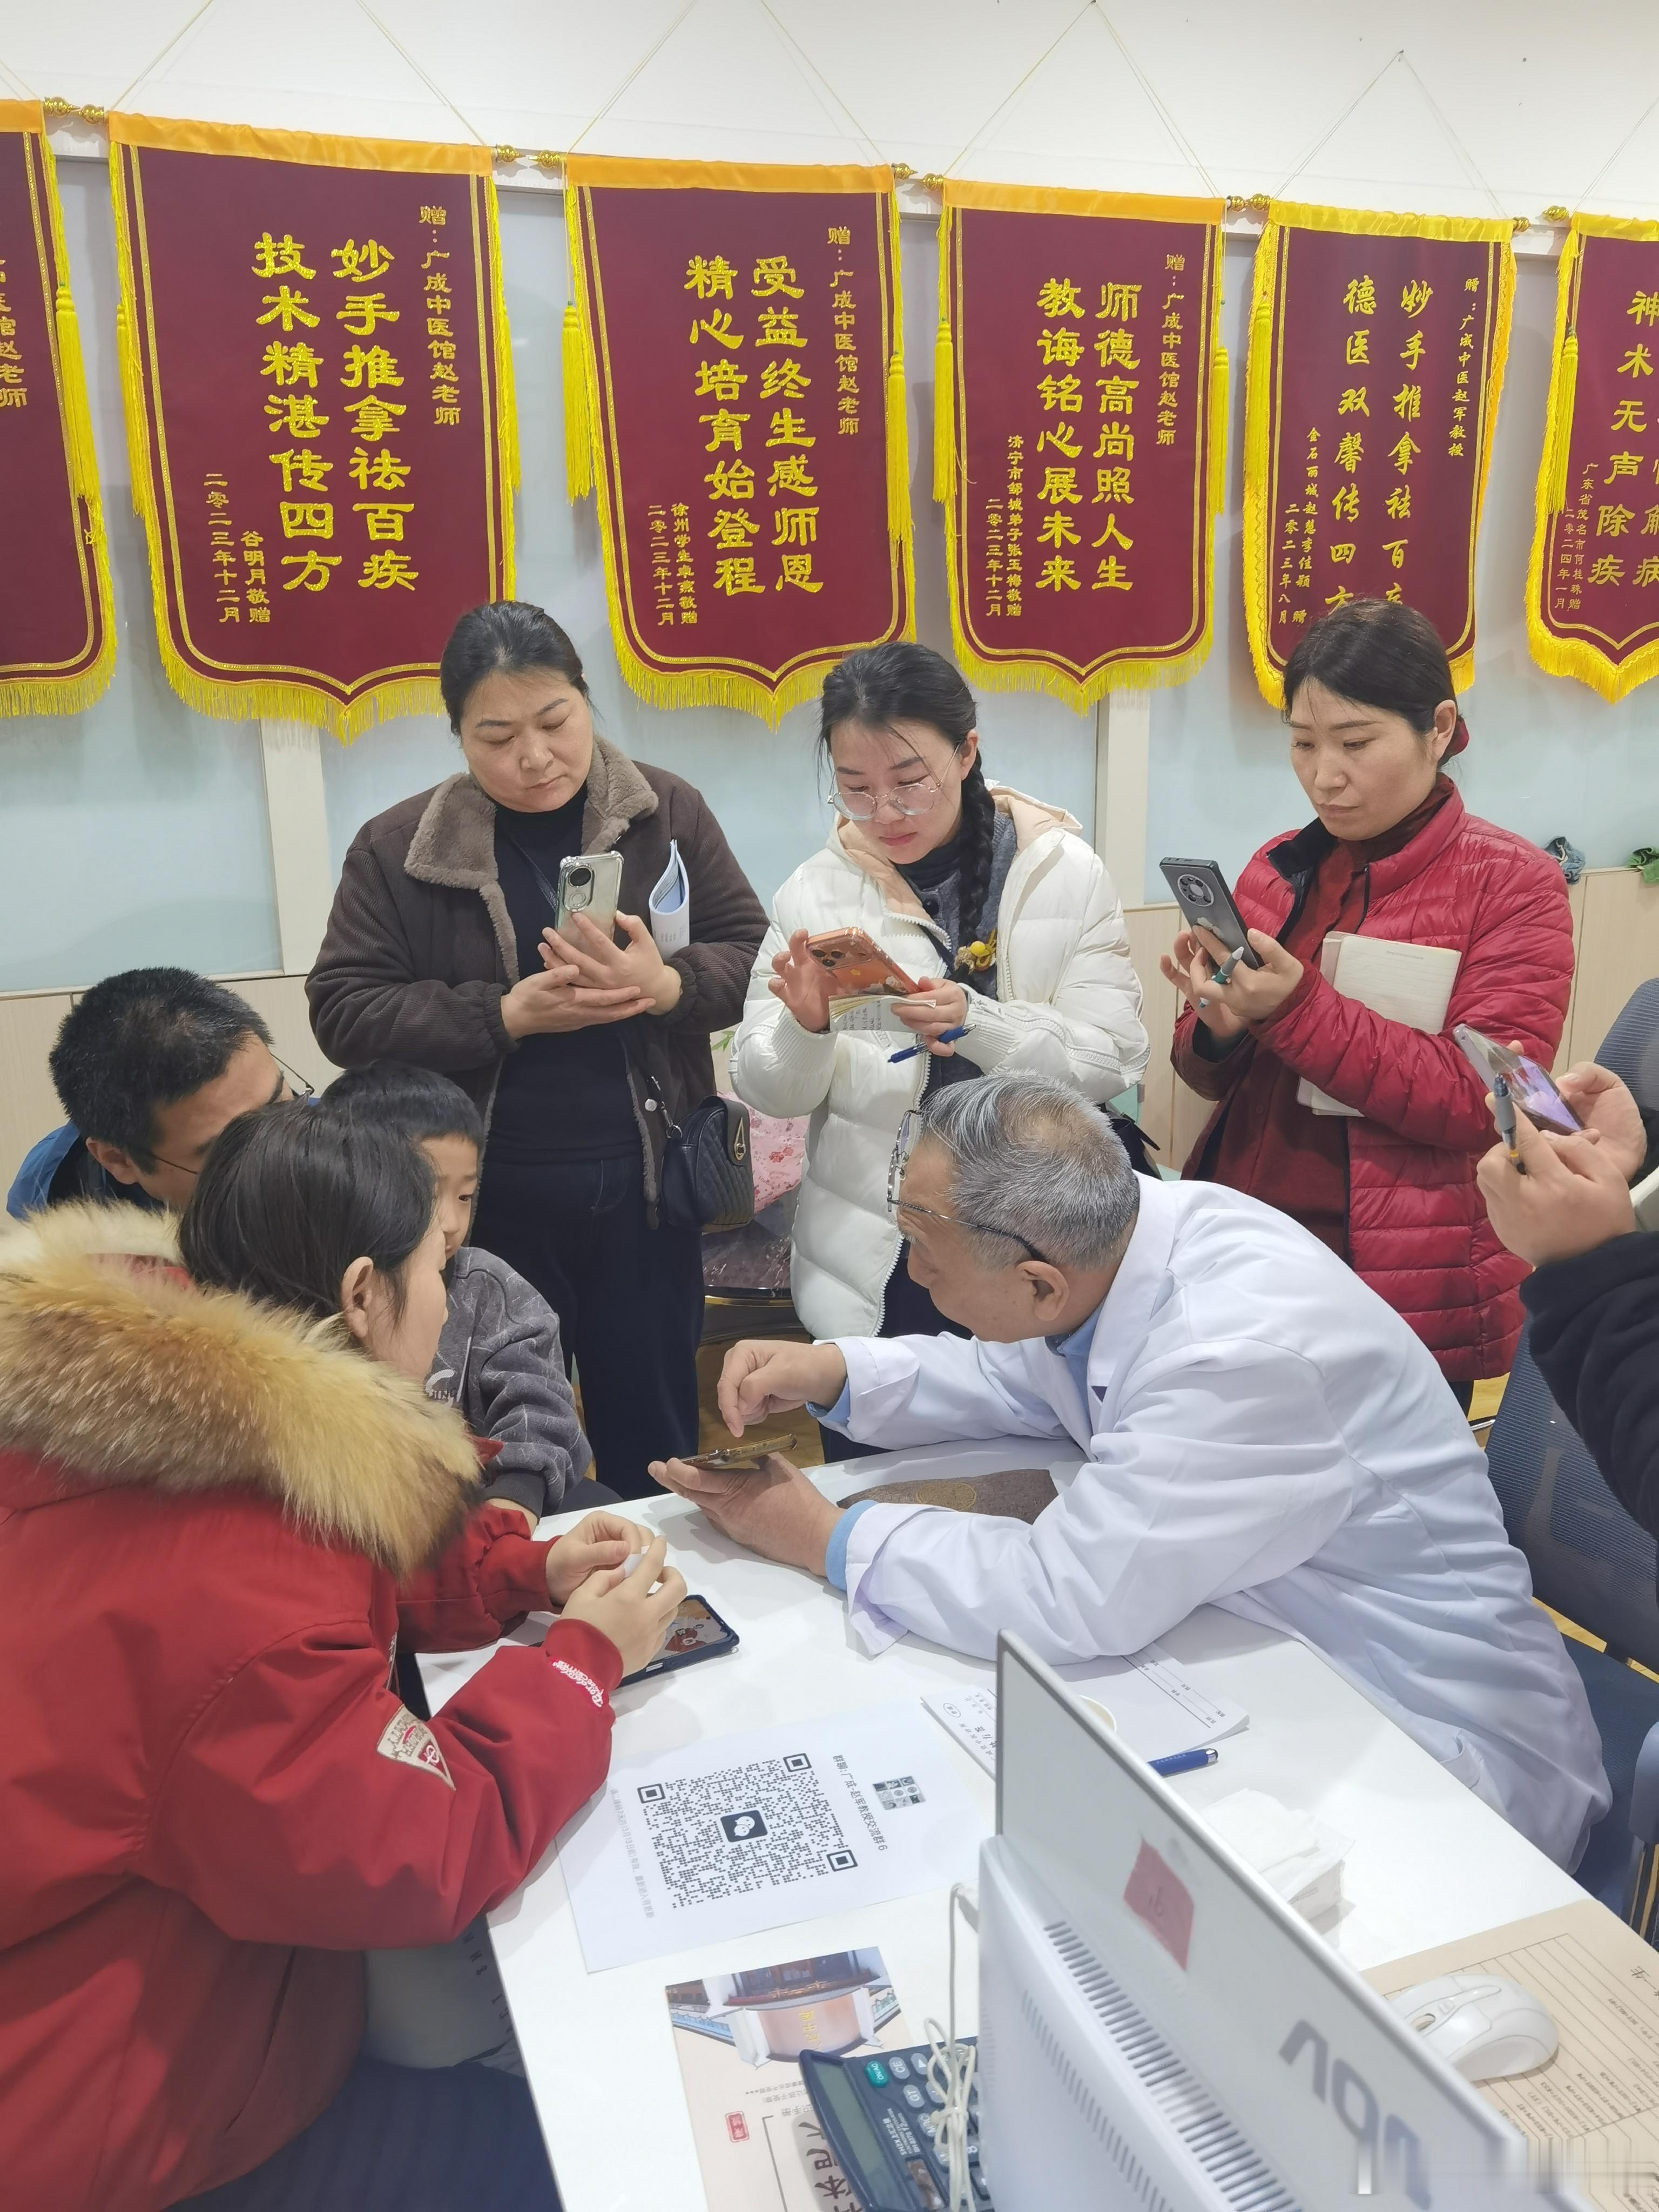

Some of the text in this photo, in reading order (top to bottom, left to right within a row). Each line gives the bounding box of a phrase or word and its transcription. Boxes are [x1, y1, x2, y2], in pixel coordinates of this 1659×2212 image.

[252, 232, 342, 591] 技术精湛传四方
[331, 239, 419, 591] 妙手推拿祛百疾
[419, 206, 461, 426] 赠：广成中医馆赵老师
[827, 226, 859, 435] 赠：广成中医馆赵老师
[1156, 254, 1185, 446] 赠：广成中医馆赵老师
[1448, 277, 1480, 457] 赠：广成中医赵军教授
[684, 254, 766, 596] 精心培育始登程
[751, 255, 824, 594] 受益终生感师恩
[1035, 278, 1086, 592] 教诲铭心展未来
[1091, 281, 1142, 591] 师德高尚照人生
[204, 473, 240, 623] 二零二三年十二月
[241, 530, 271, 623] 谷明月敬赠
[648, 504, 675, 626] 二零二三年十二月
[985, 498, 1004, 617] 二零二三年十二月
[1278, 503, 1300, 624] 二零二三年八月
[1554, 508, 1575, 609] 二零二四年一月
